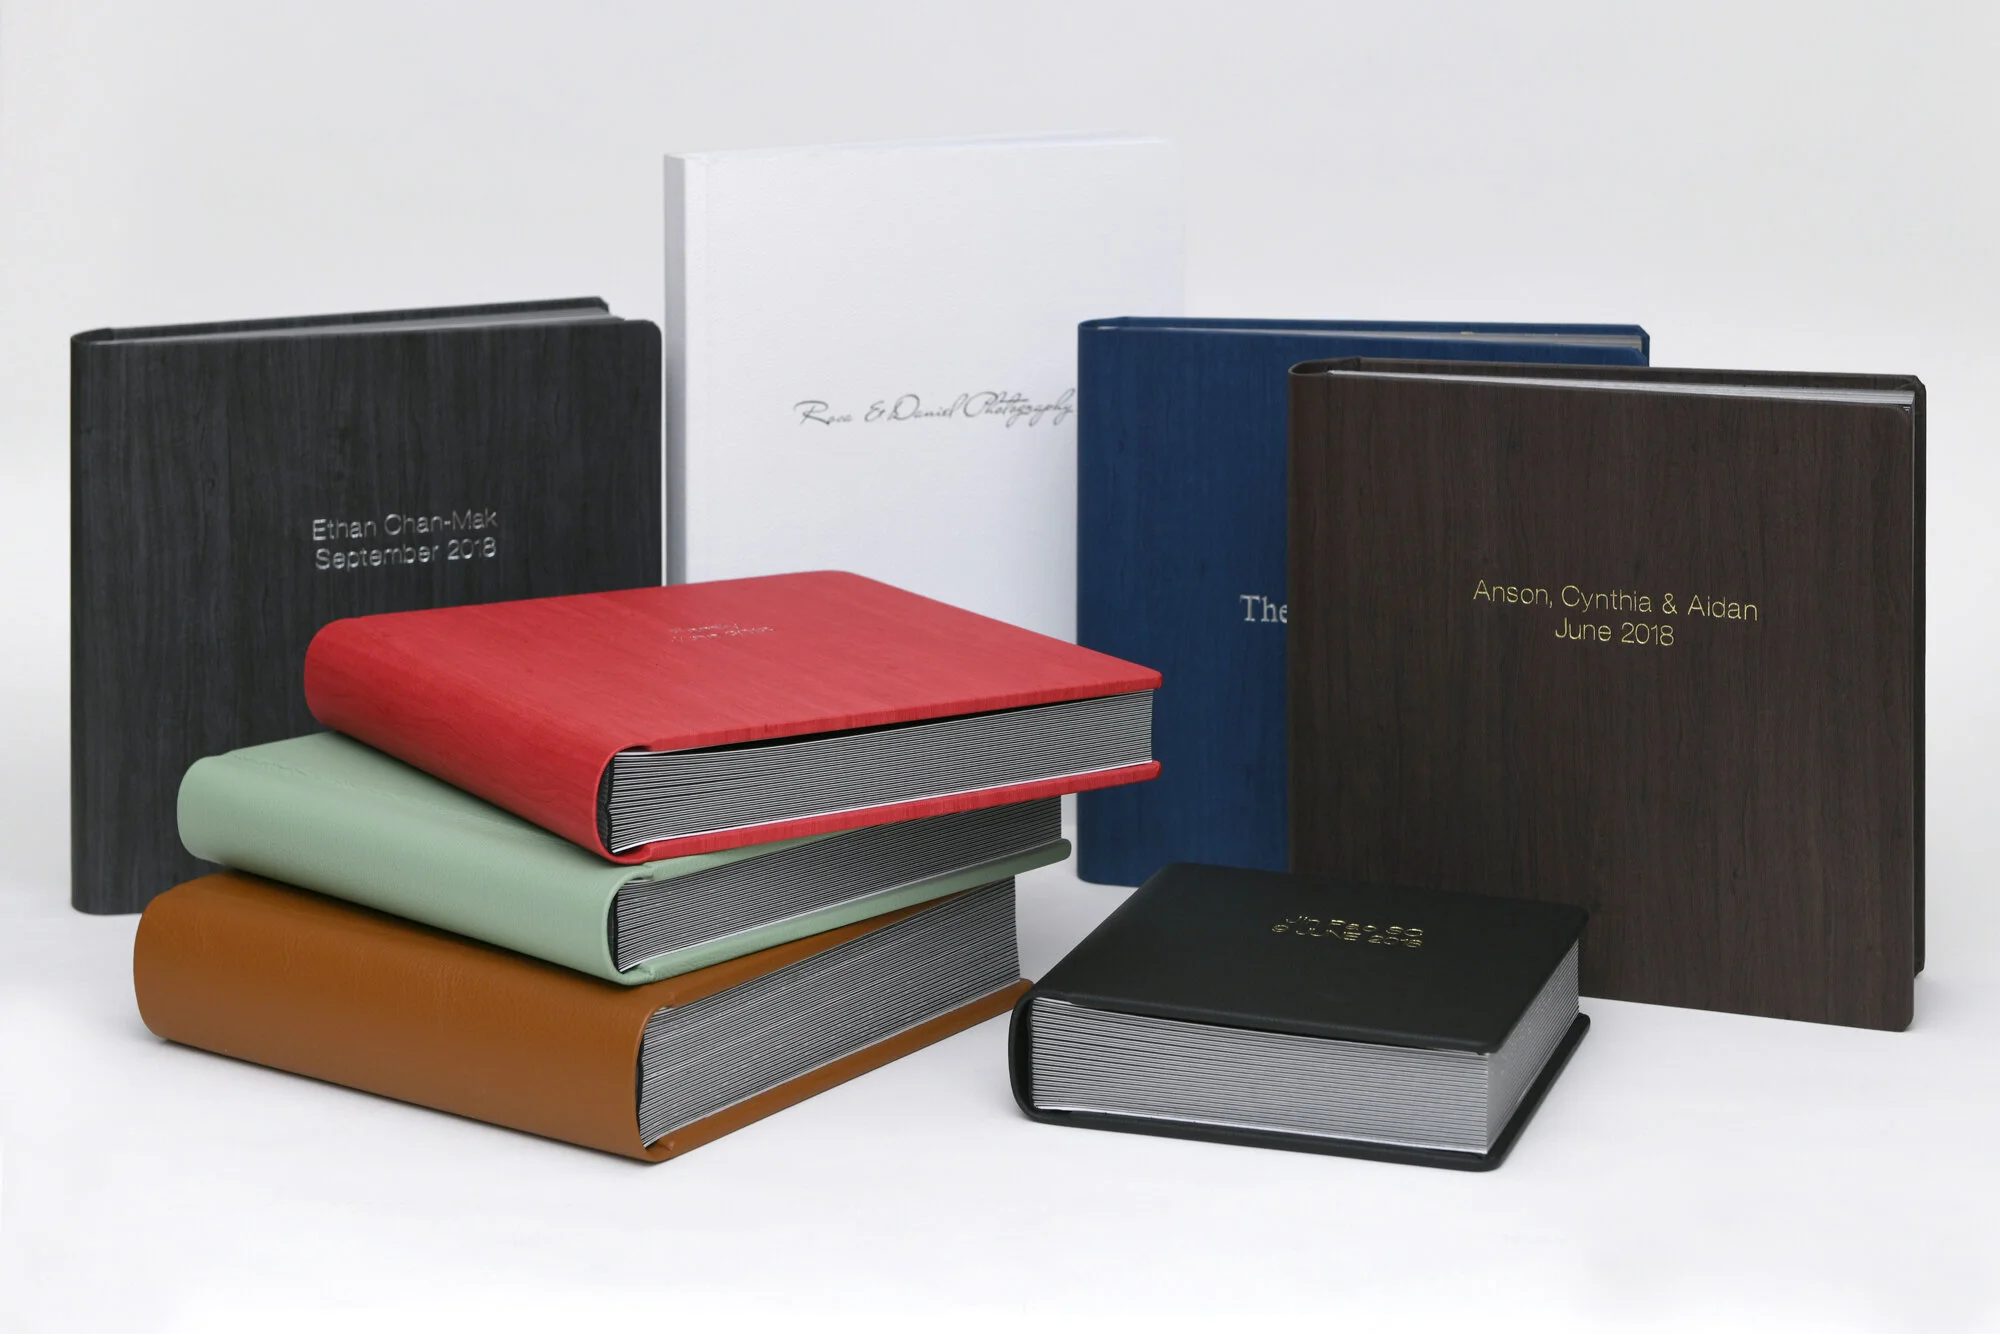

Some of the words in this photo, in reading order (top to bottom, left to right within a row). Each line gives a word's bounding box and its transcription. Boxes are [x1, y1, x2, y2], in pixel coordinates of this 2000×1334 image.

[887, 393, 969, 420] Daniel
[963, 388, 1076, 428] Photography
[312, 518, 377, 541] Ethan
[384, 508, 498, 535] Chan-Mak
[315, 545, 440, 572] September
[448, 537, 497, 560] 2018
[1473, 579, 1553, 608] Anson,
[1561, 585, 1652, 613] Cynthia
[1661, 593, 1678, 615] &
[1687, 595, 1759, 622] Aidan
[1555, 617, 1612, 642] June
[1621, 622, 1675, 647] 2018
[1367, 935, 1423, 948] 2018
